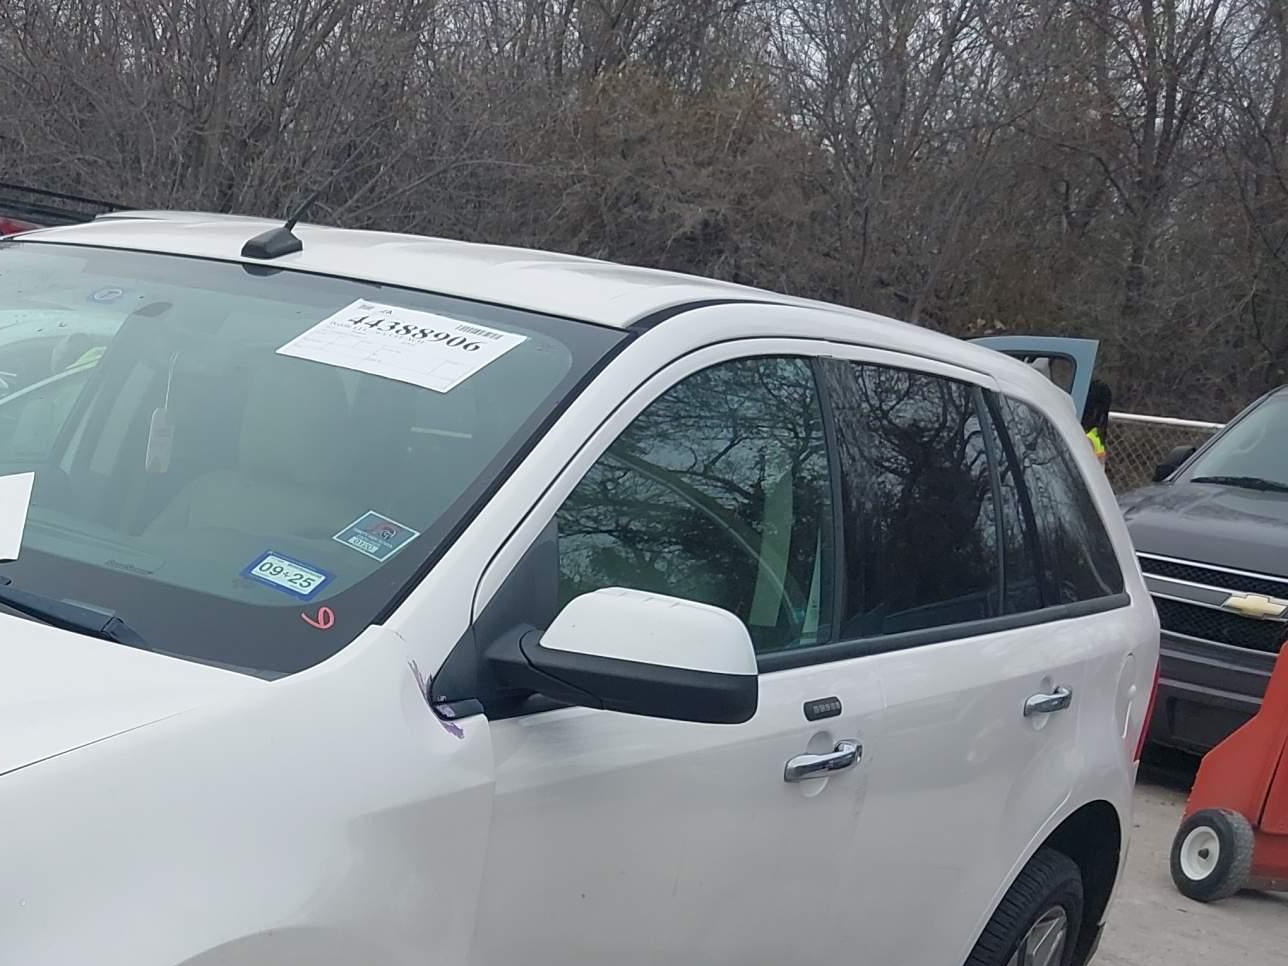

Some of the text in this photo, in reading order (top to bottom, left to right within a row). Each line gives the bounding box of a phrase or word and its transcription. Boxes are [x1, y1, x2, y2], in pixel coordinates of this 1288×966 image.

[349, 315, 481, 352] 44388906
[259, 561, 316, 589] 09 25
